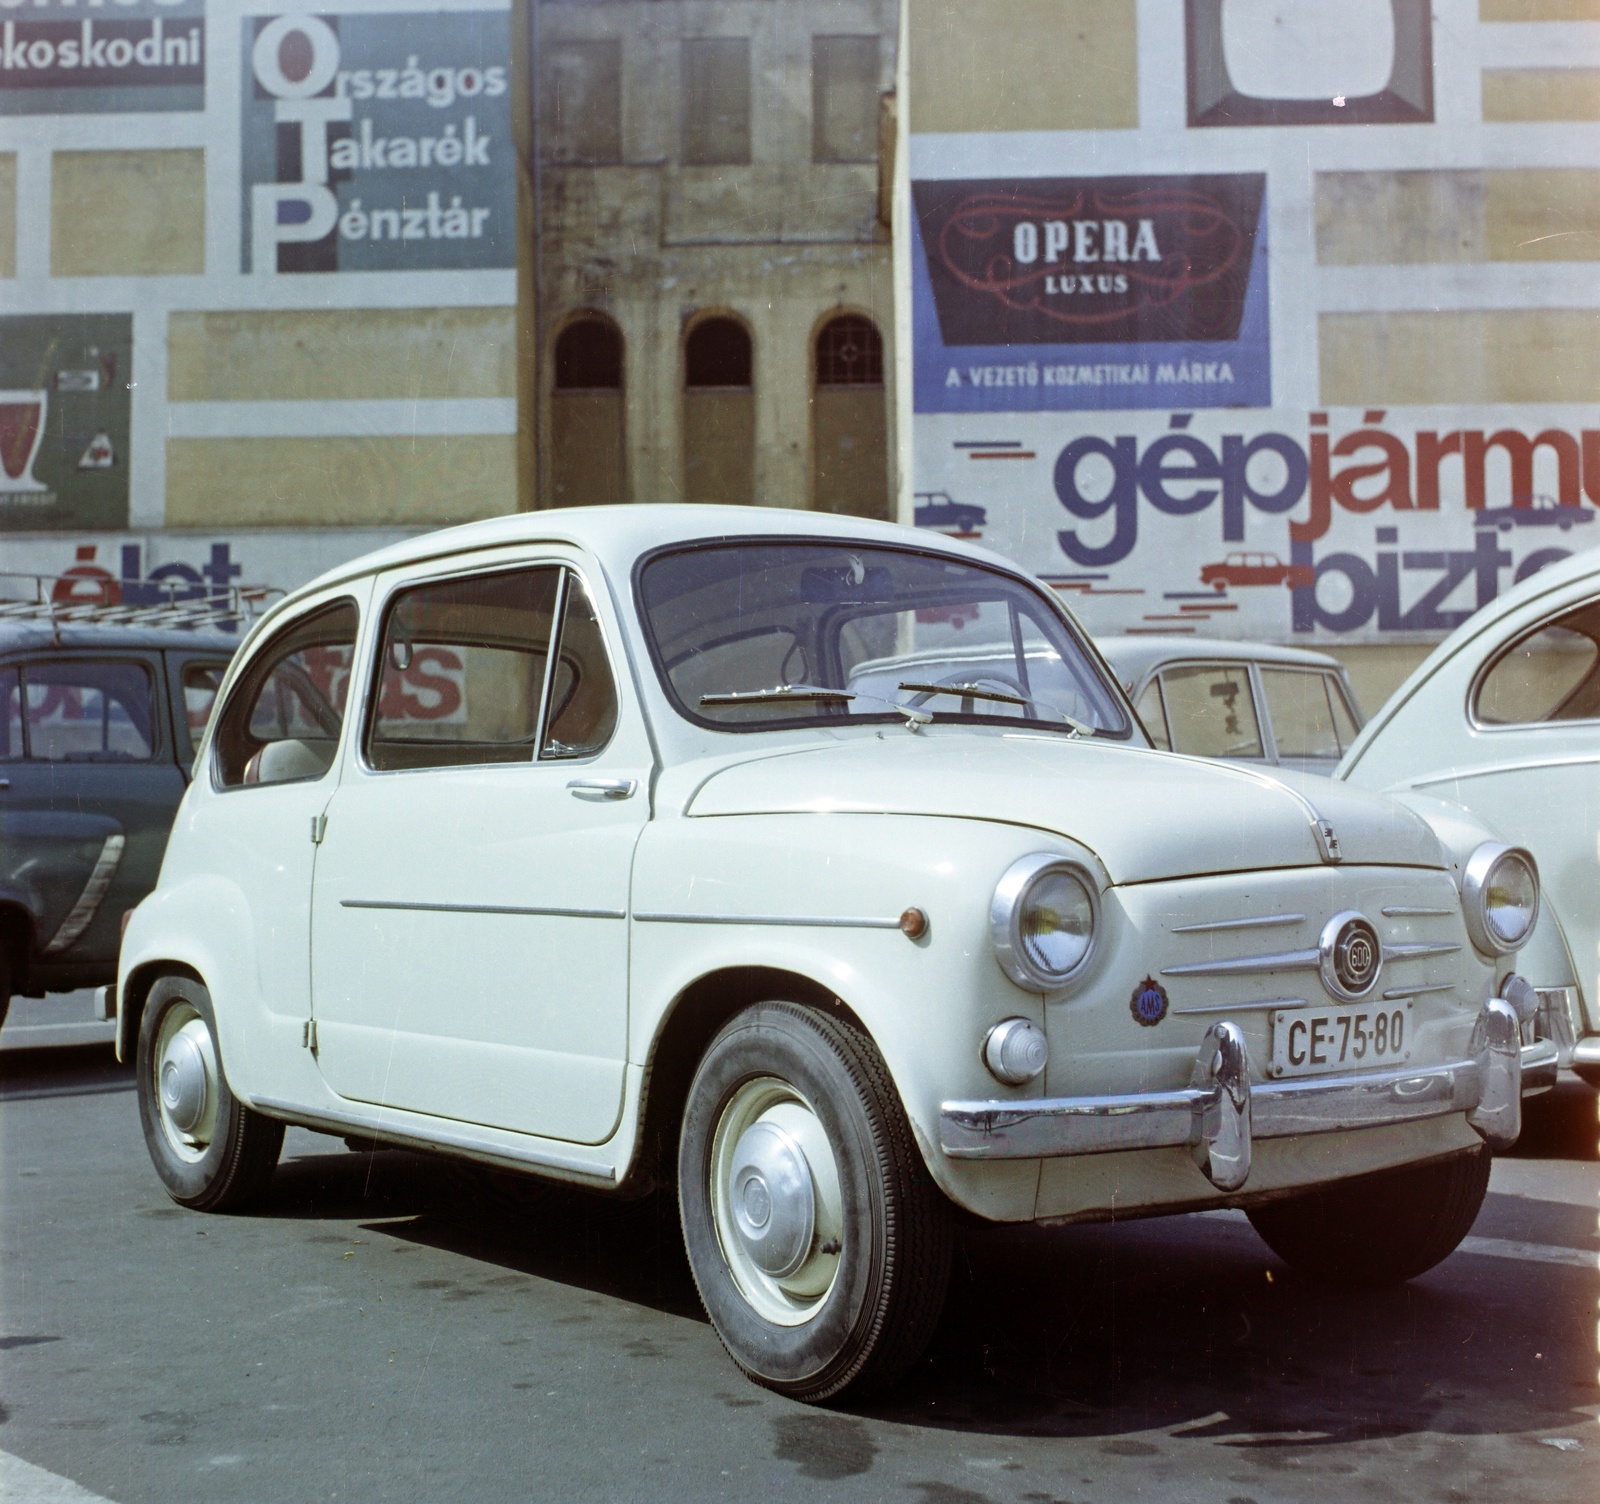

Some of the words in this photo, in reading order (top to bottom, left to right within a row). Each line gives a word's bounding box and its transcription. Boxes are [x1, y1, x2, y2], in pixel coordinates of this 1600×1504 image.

[0, 16, 200, 70] koskodni
[252, 15, 507, 108] Országos
[274, 97, 491, 186] Takarék
[252, 182, 490, 273] Pénztár
[1013, 218, 1163, 264] OPERA
[1045, 274, 1128, 295] LUXUS
[945, 367, 961, 387] A
[1043, 363, 1148, 386] KOZMETIKAI
[1155, 357, 1234, 384] MÁRKA
[1351, 946, 1368, 967] 600
